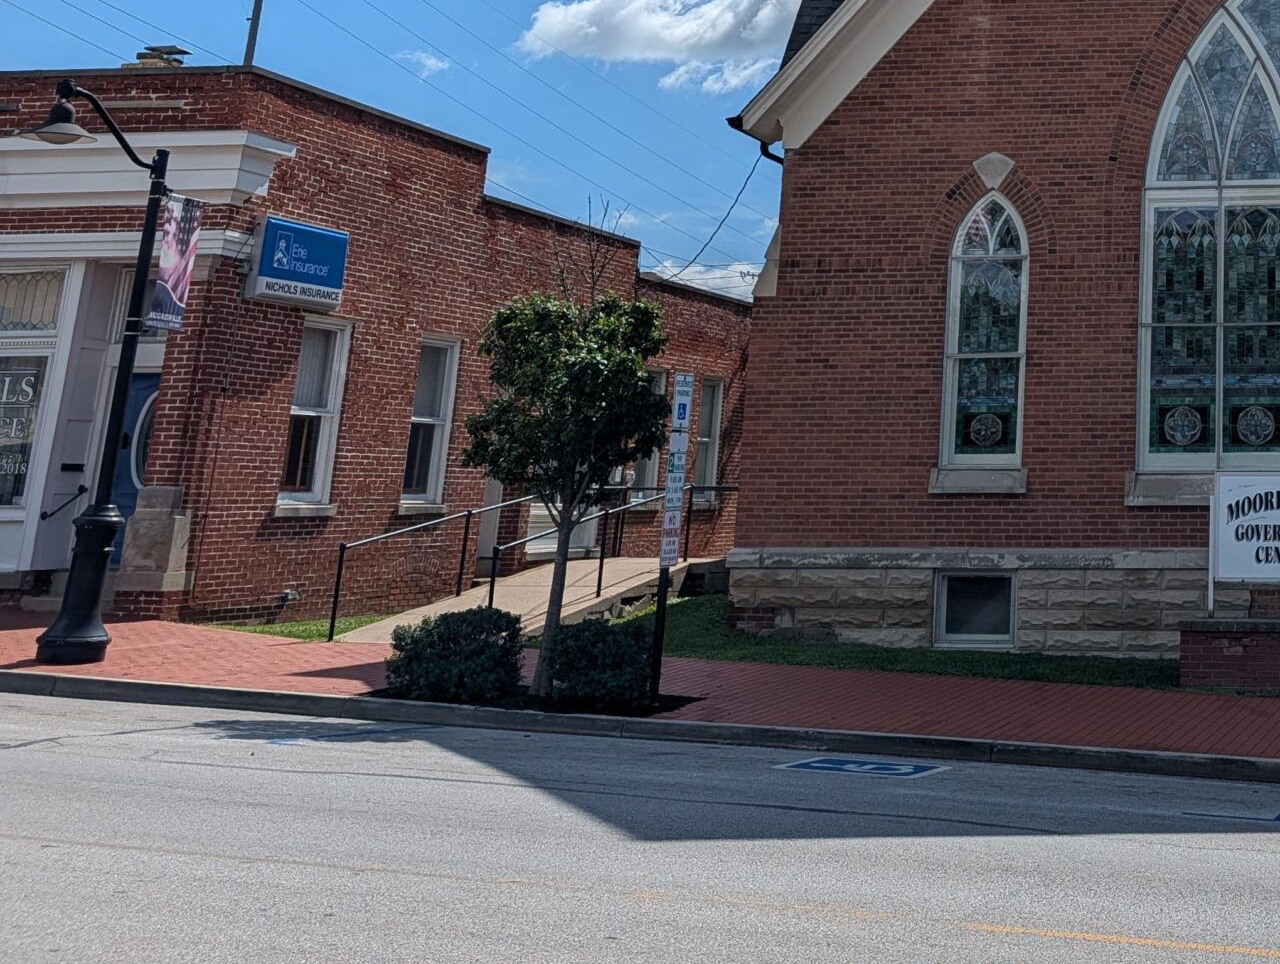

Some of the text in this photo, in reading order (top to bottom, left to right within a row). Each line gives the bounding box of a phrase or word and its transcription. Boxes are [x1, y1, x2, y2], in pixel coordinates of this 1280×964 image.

[292, 243, 308, 259] Erie
[290, 260, 328, 276] Insurance
[265, 281, 340, 302] NICHOLS INSURANCE
[669, 456, 675, 470] 2
